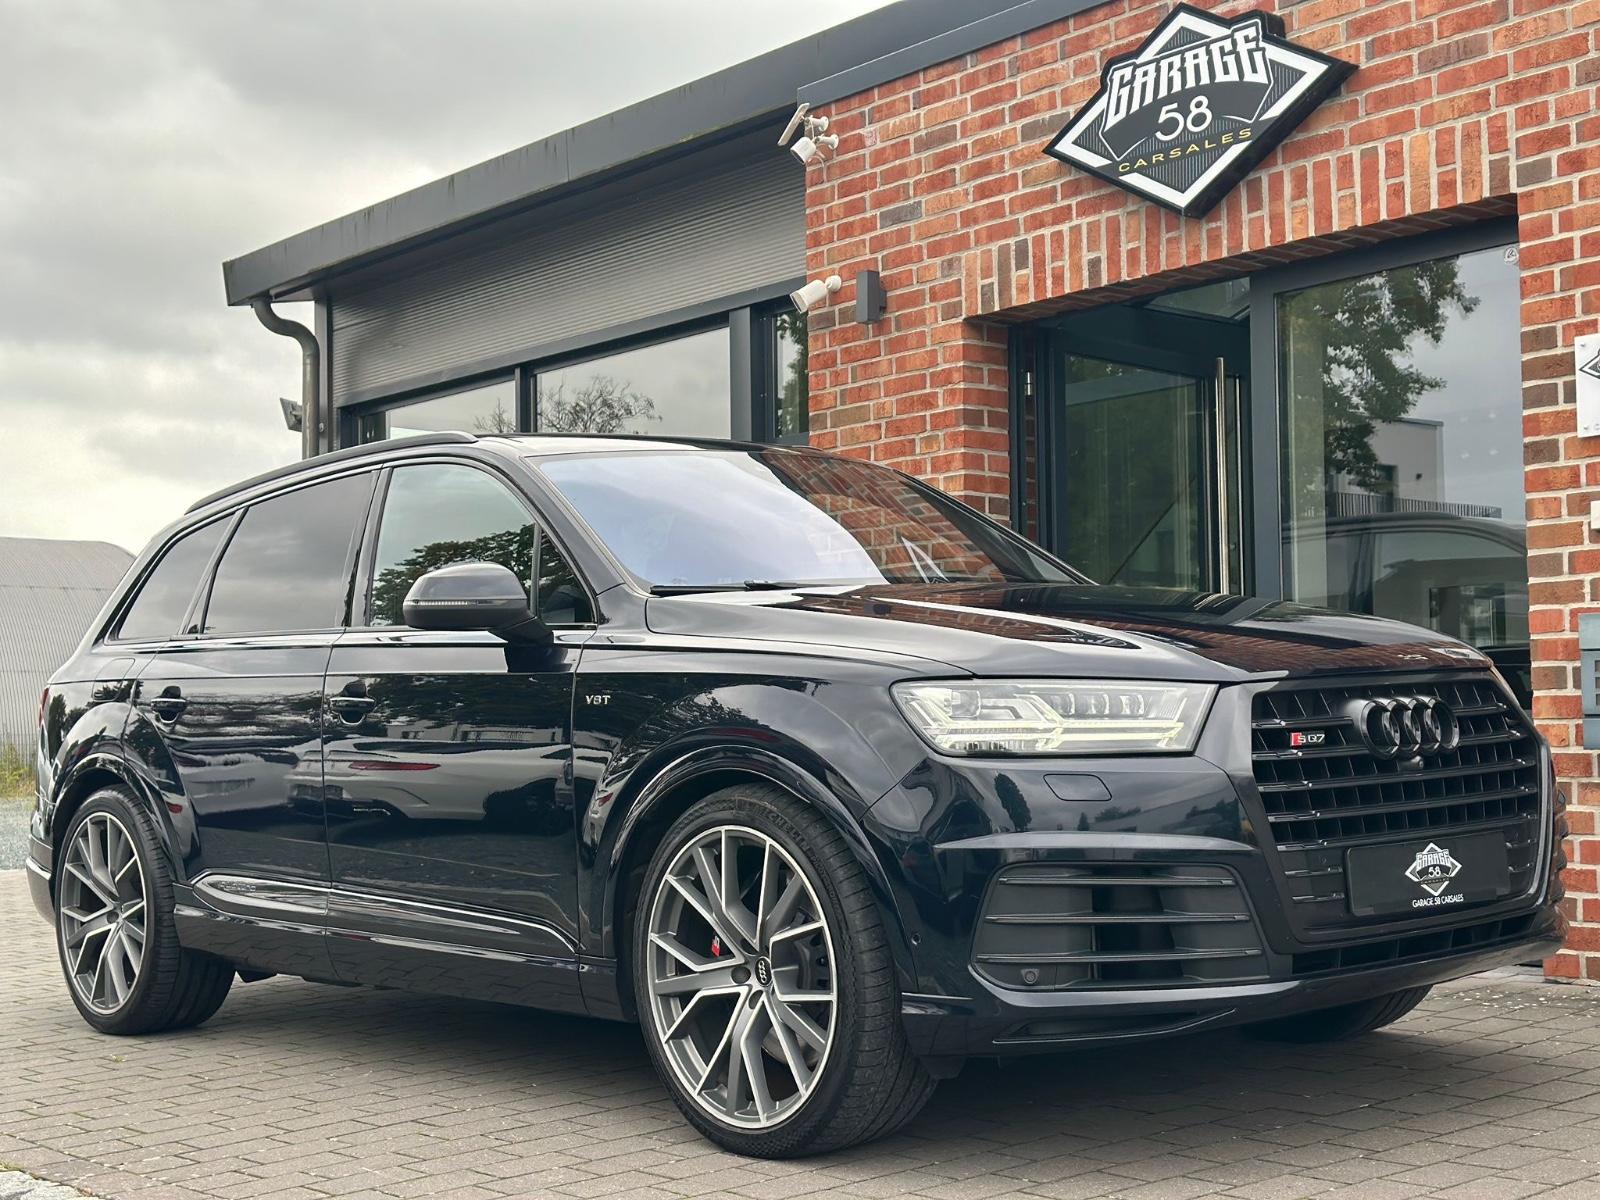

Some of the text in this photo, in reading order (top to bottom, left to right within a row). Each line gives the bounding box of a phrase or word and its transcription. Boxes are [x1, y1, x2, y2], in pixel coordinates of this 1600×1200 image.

[1105, 28, 1268, 132] GARAGE
[1154, 95, 1213, 141] 58
[1118, 128, 1252, 172] CARSALES
[1296, 733, 1326, 743] SQ7
[1417, 850, 1451, 870] GARAGE
[1428, 866, 1441, 878] 58
[1412, 893, 1464, 908] GARAGE 58 CARSALES
